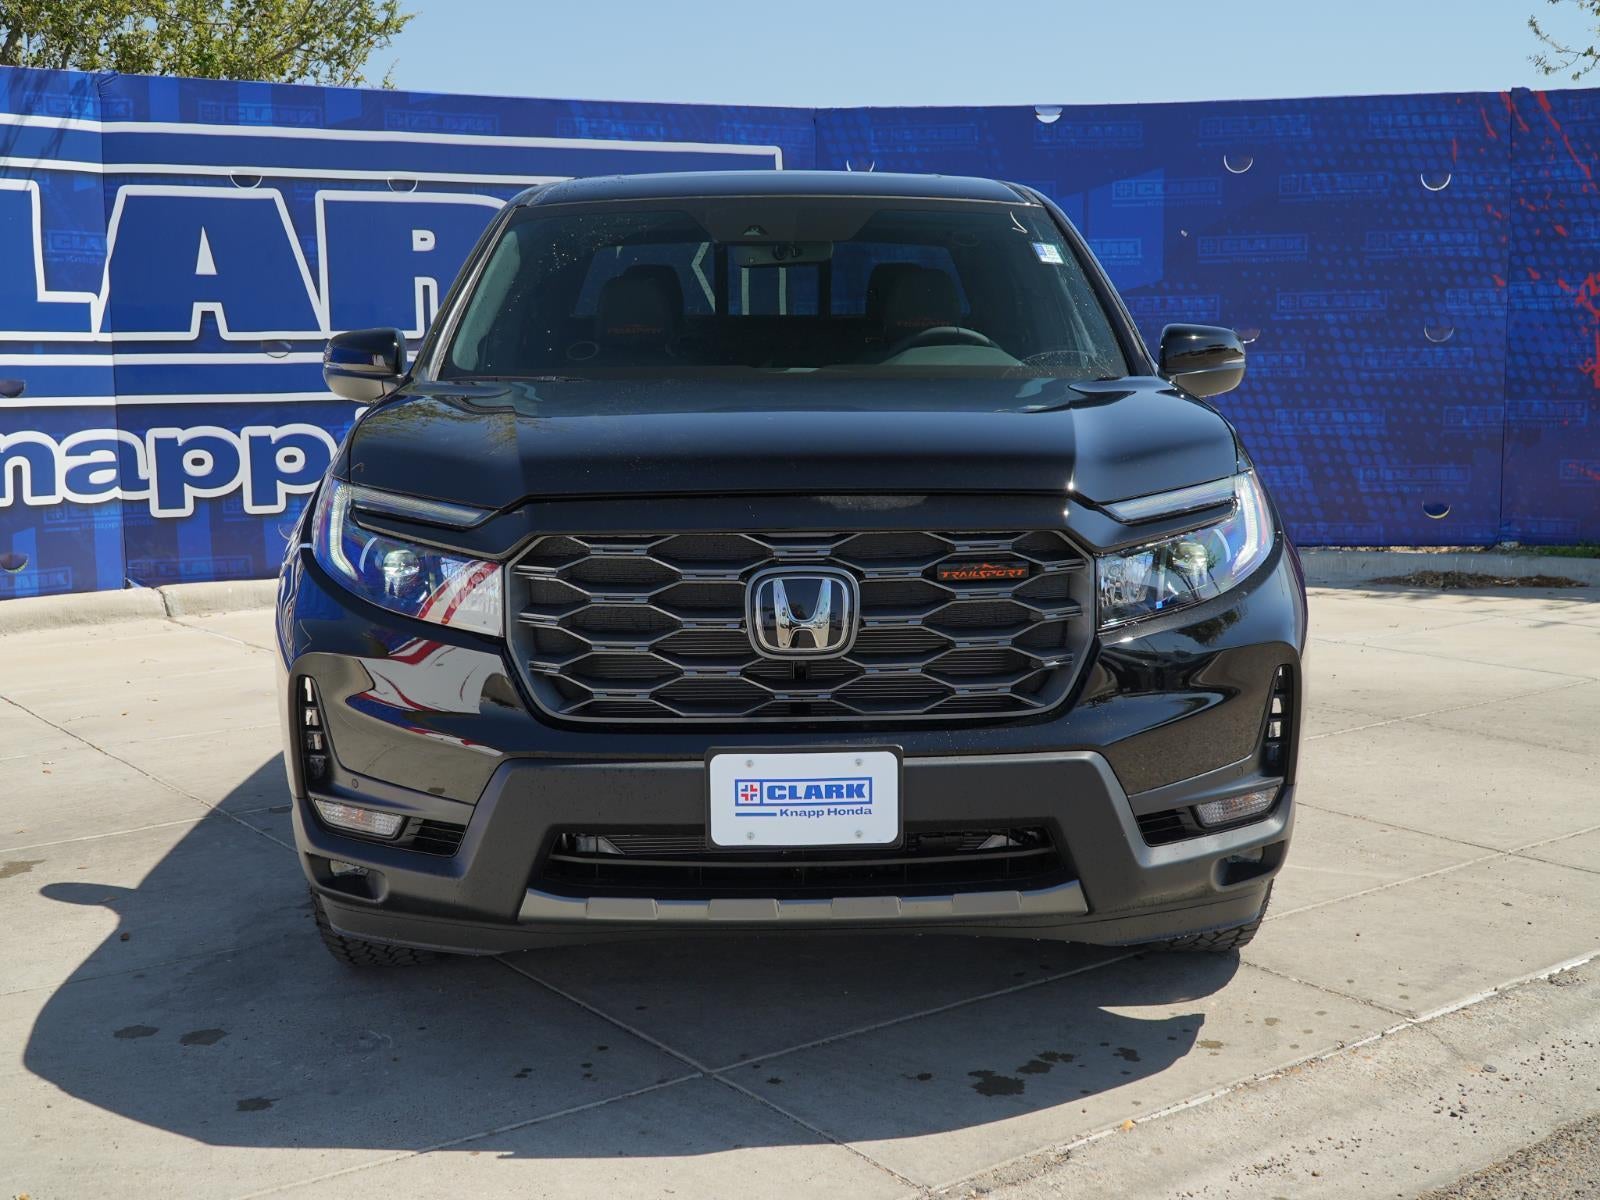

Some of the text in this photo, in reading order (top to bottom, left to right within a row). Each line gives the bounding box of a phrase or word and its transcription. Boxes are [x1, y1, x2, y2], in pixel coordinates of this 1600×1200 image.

[940, 568, 1026, 580] TRAILSPORT
[766, 783, 866, 801] CLARK
[779, 806, 873, 819] Knapp Honda
